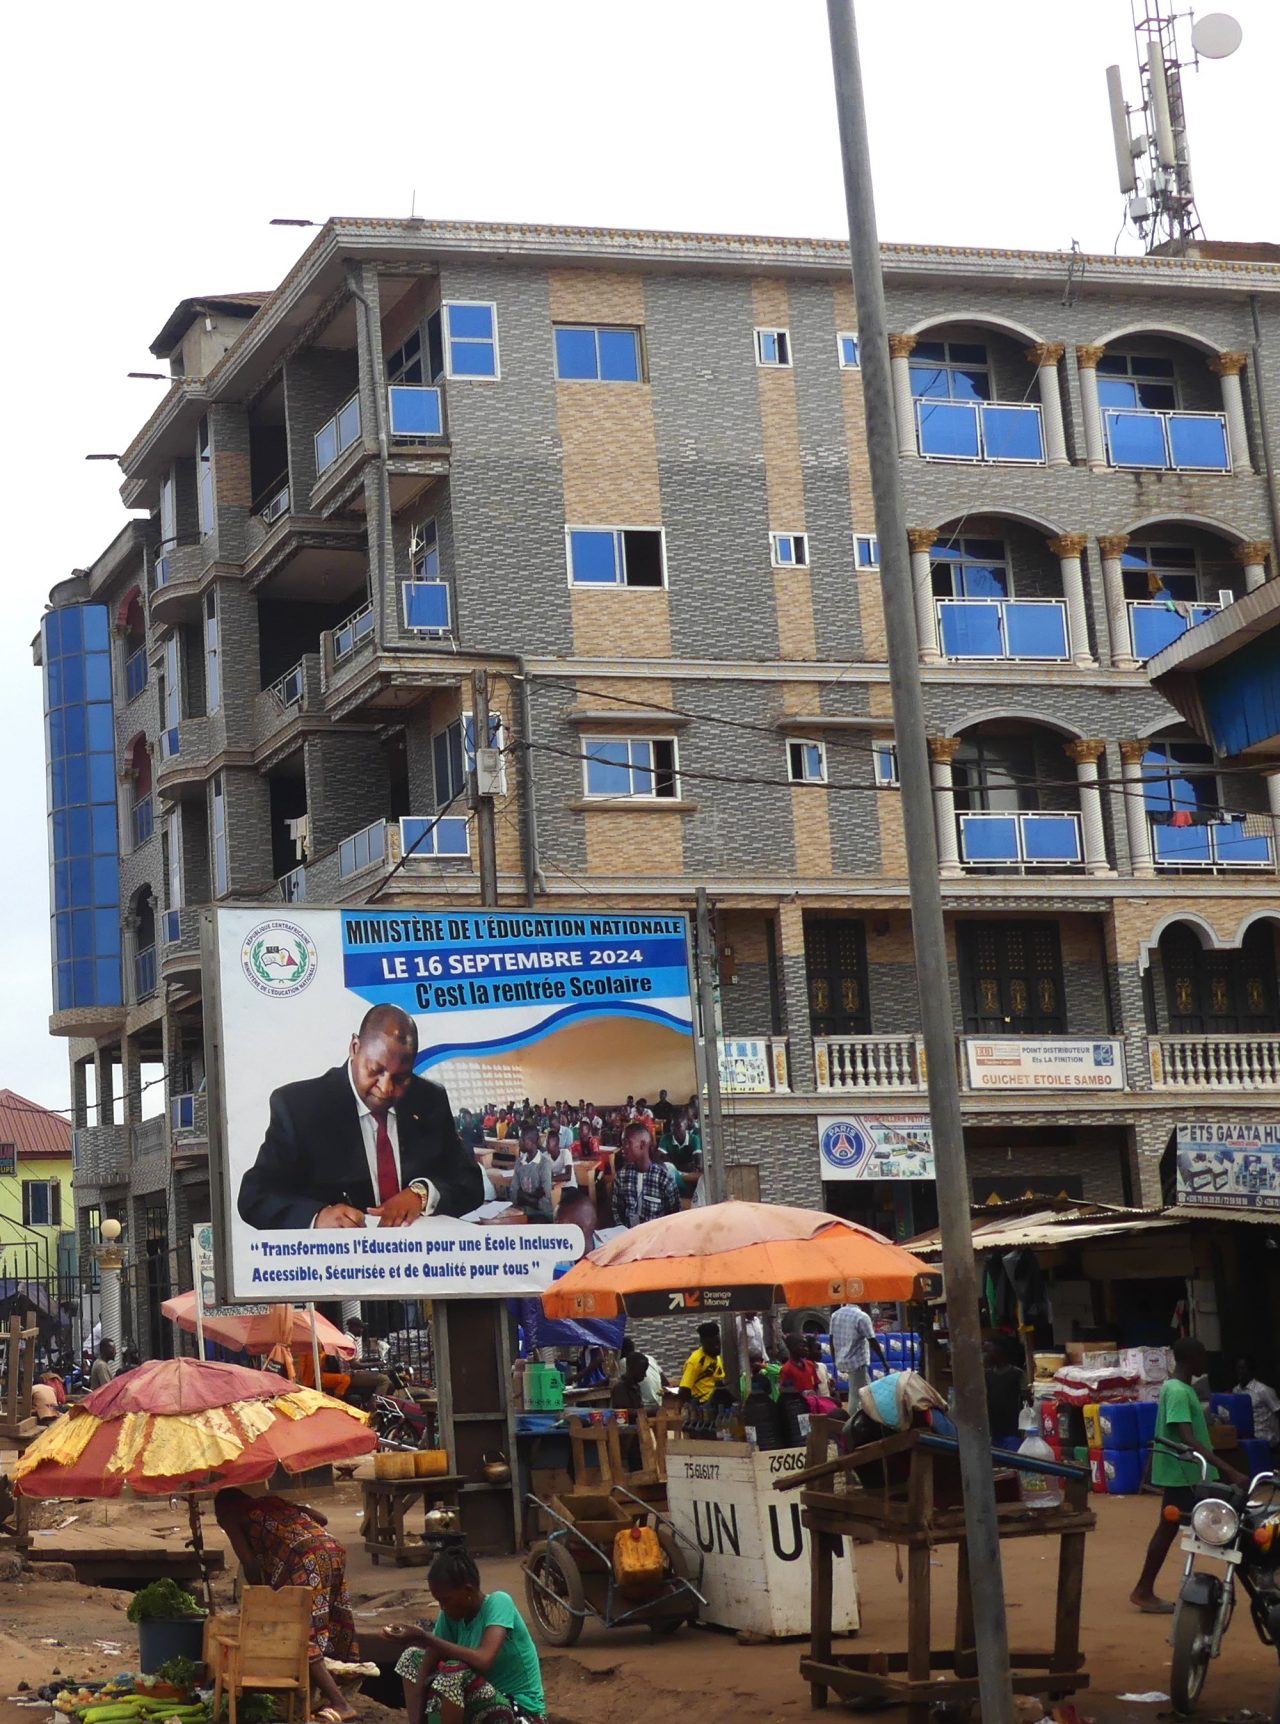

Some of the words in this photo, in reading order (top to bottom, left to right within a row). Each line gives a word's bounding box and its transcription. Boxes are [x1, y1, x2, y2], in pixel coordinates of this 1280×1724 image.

[346, 915, 445, 945] MINISTÈRE
[449, 919, 470, 941] DE
[474, 916, 586, 940] L'ÉDUCATION
[590, 920, 682, 936] NATIONALE
[381, 955, 408, 979] LE
[414, 955, 443, 977] 16
[449, 950, 584, 974] SEPTEMBRE
[589, 949, 644, 965] 2024
[416, 982, 467, 1010] C'est
[470, 984, 489, 1004] la
[493, 977, 567, 1002] rentrée
[571, 975, 653, 997] Scolaire
[982, 1074, 1030, 1085] GUICHET
[1034, 1075, 1071, 1085] ETOILE
[1074, 1075, 1112, 1085] SAMBO
[828, 1125, 856, 1138] PARIS
[1190, 1125, 1213, 1142] ETS
[261, 1240, 351, 1256] Transformons
[353, 1236, 423, 1255] l'Éducation
[426, 1241, 456, 1255] pour
[458, 1239, 482, 1252] une
[484, 1232, 516, 1251] École
[252, 1264, 323, 1282] Accessible,
[325, 1262, 386, 1280] Sécurisée
[389, 1263, 401, 1279] et
[404, 1263, 419, 1278] de
[422, 1261, 467, 1277] Qualité
[469, 1264, 500, 1279] pour
[503, 1262, 530, 1276] tous
[703, 1291, 732, 1299] Orange
[704, 1298, 730, 1307] Money
[692, 1500, 741, 1556] UN
